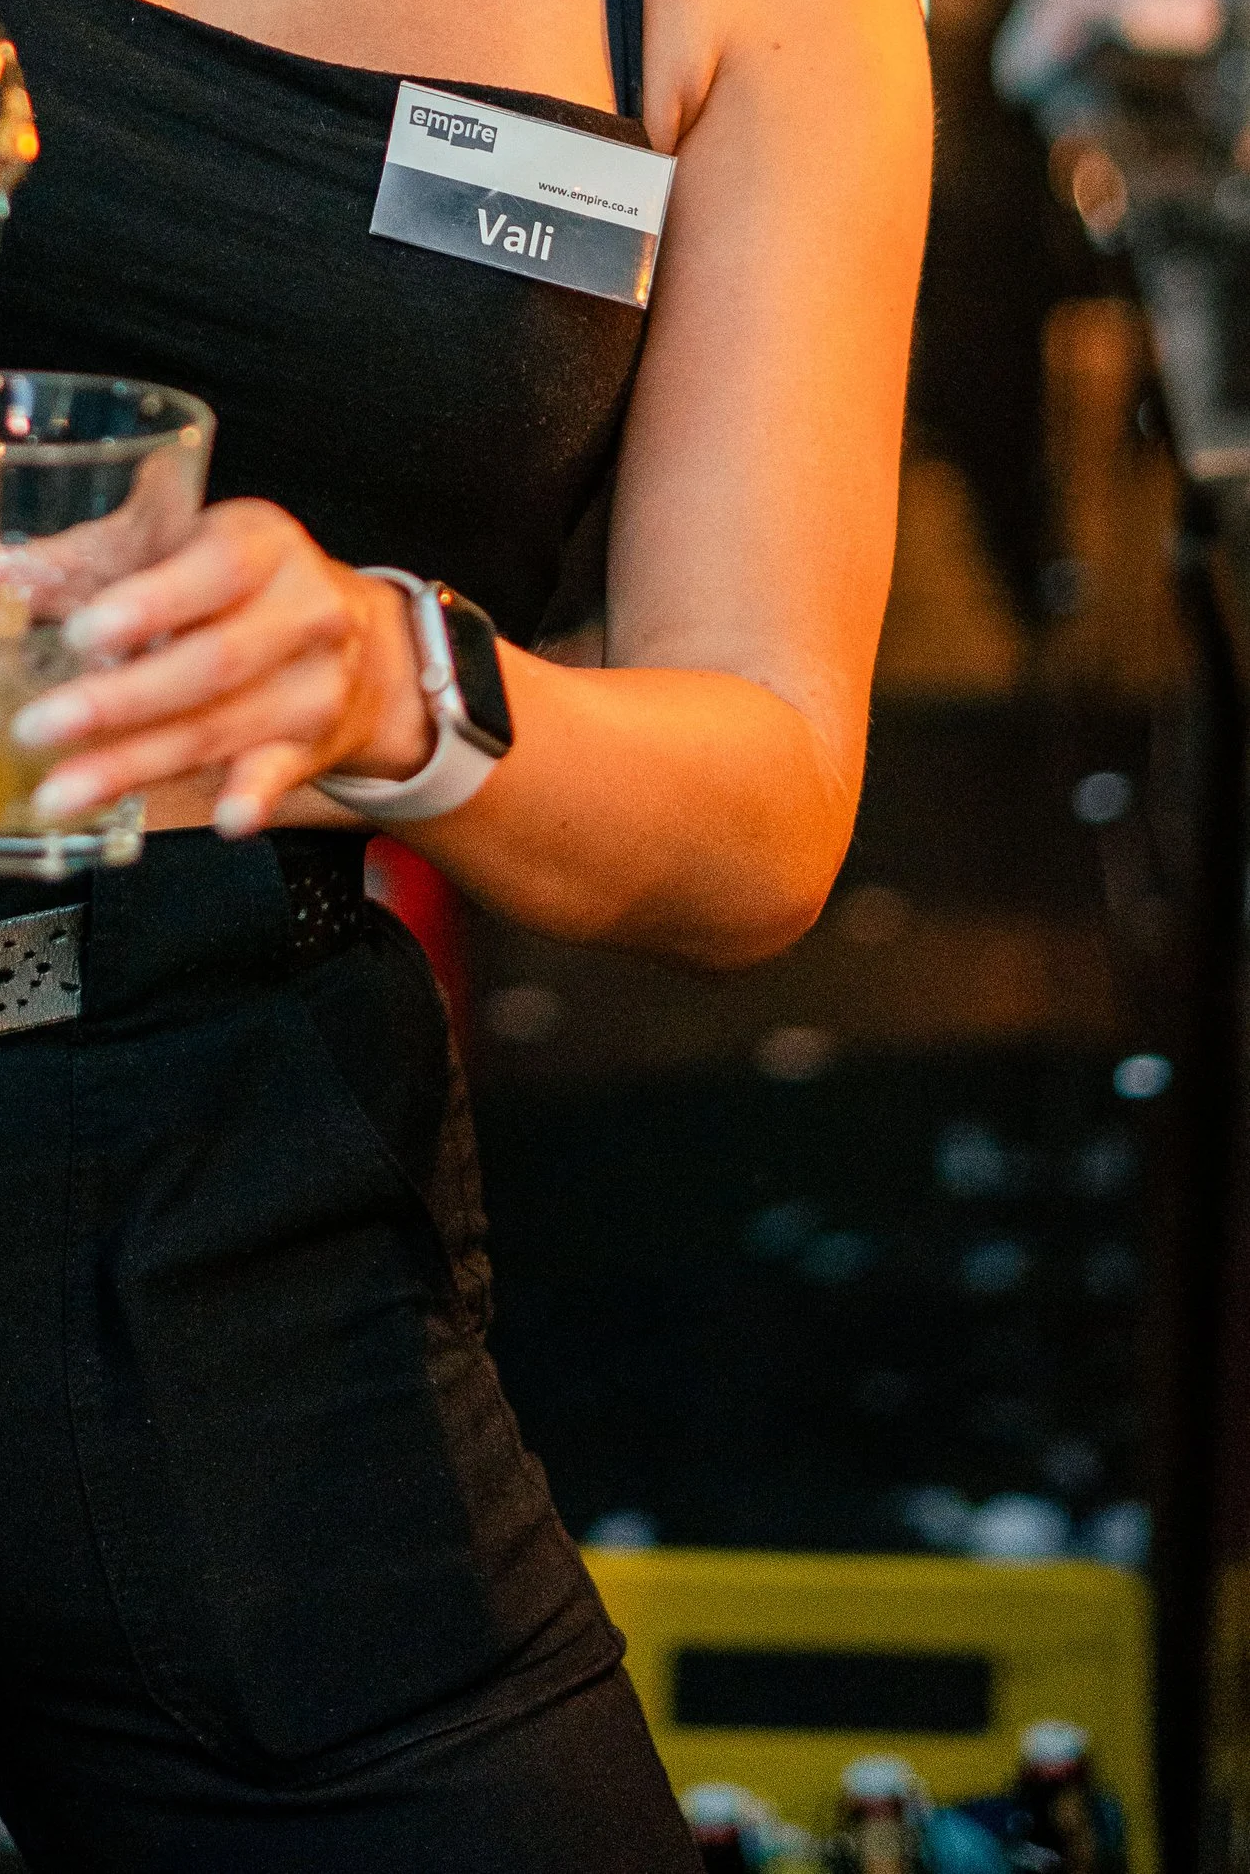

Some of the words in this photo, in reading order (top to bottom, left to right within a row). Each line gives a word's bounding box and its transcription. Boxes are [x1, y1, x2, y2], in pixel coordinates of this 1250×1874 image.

[411, 108, 496, 144] empire
[538, 182, 639, 216] www.empire.co.at
[477, 208, 554, 261] Vali
